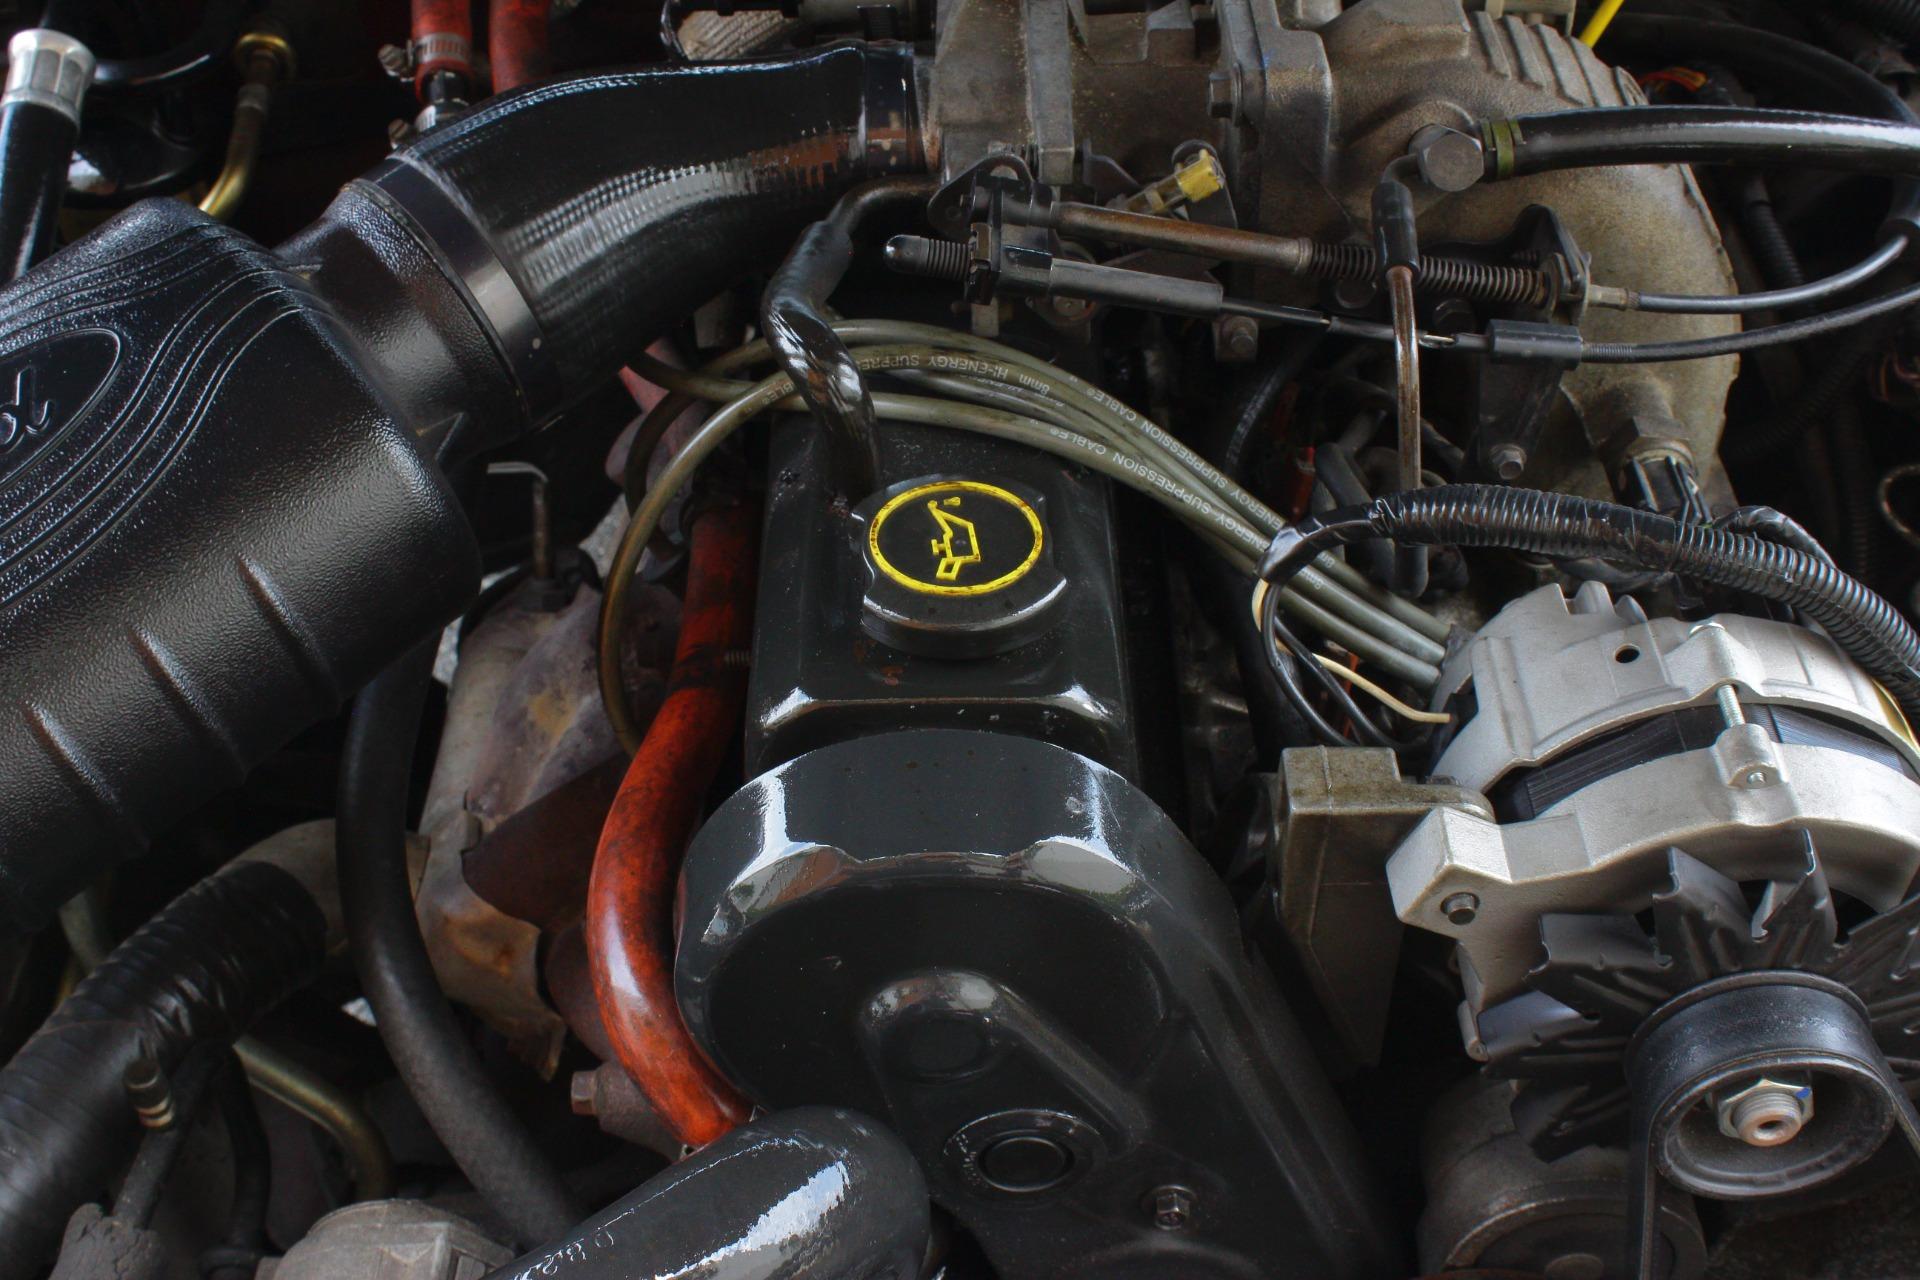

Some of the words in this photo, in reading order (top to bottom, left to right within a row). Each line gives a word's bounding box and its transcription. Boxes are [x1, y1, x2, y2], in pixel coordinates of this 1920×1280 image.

[856, 354, 920, 371] SUPPRE
[1019, 373, 1050, 396] 8mm
[1139, 420, 1229, 489] SUPPRESSION
[1112, 452, 1213, 515] SUPPRESSION
